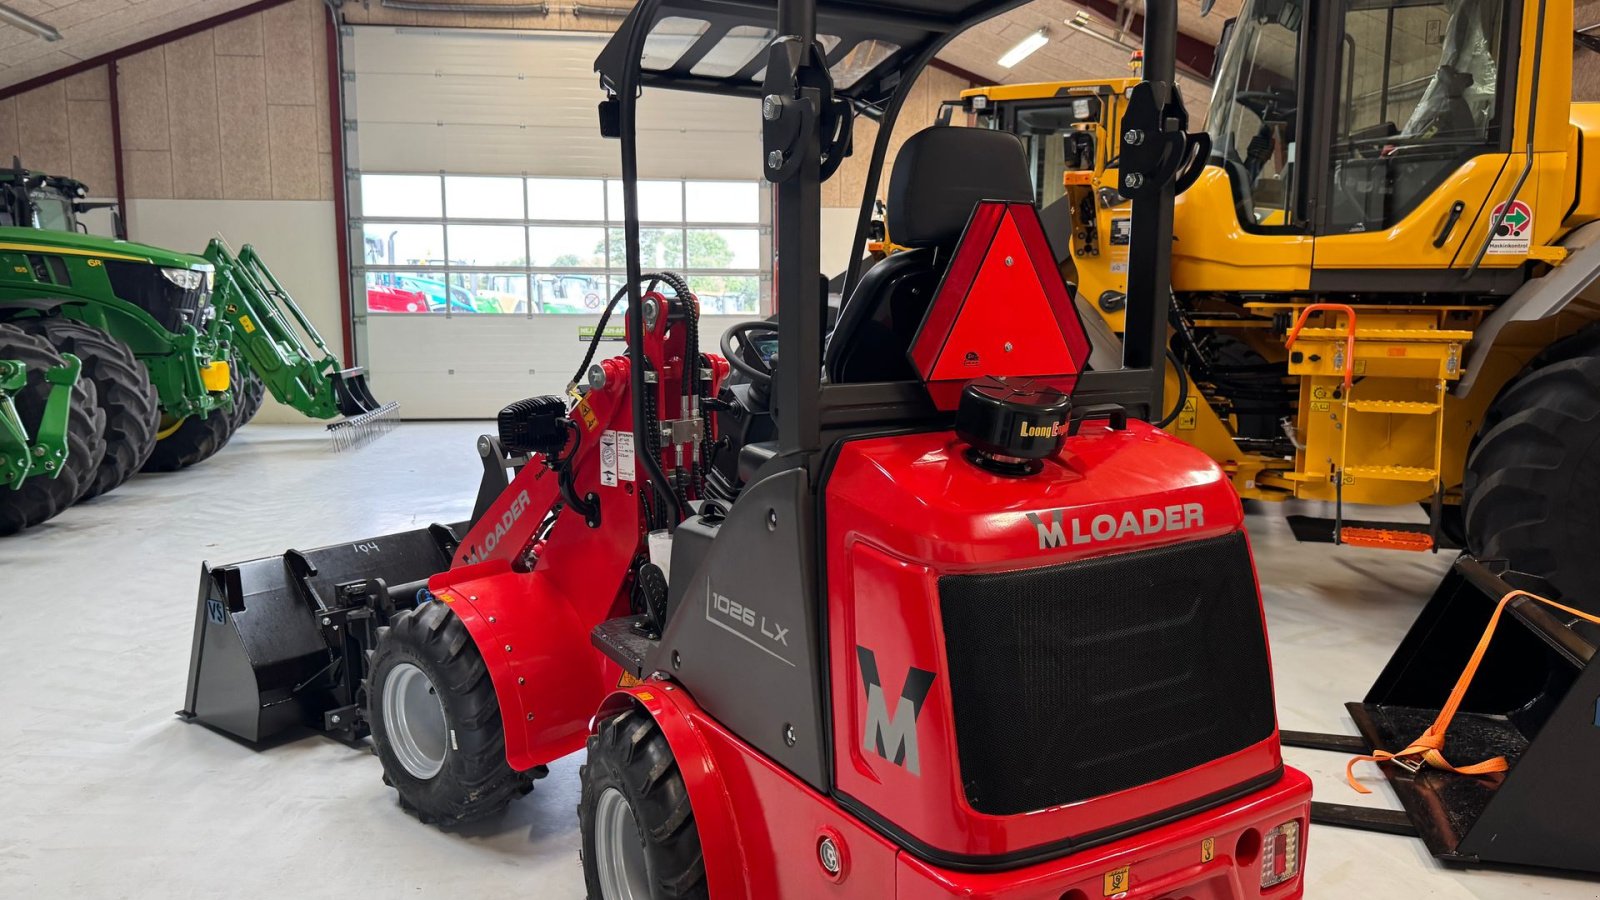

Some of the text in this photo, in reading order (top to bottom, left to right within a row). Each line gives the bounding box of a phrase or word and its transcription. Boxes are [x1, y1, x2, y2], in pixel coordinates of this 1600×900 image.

[478, 489, 530, 561] LOADER
[1072, 503, 1204, 544] LOADER
[713, 592, 789, 647] 1026 LX
